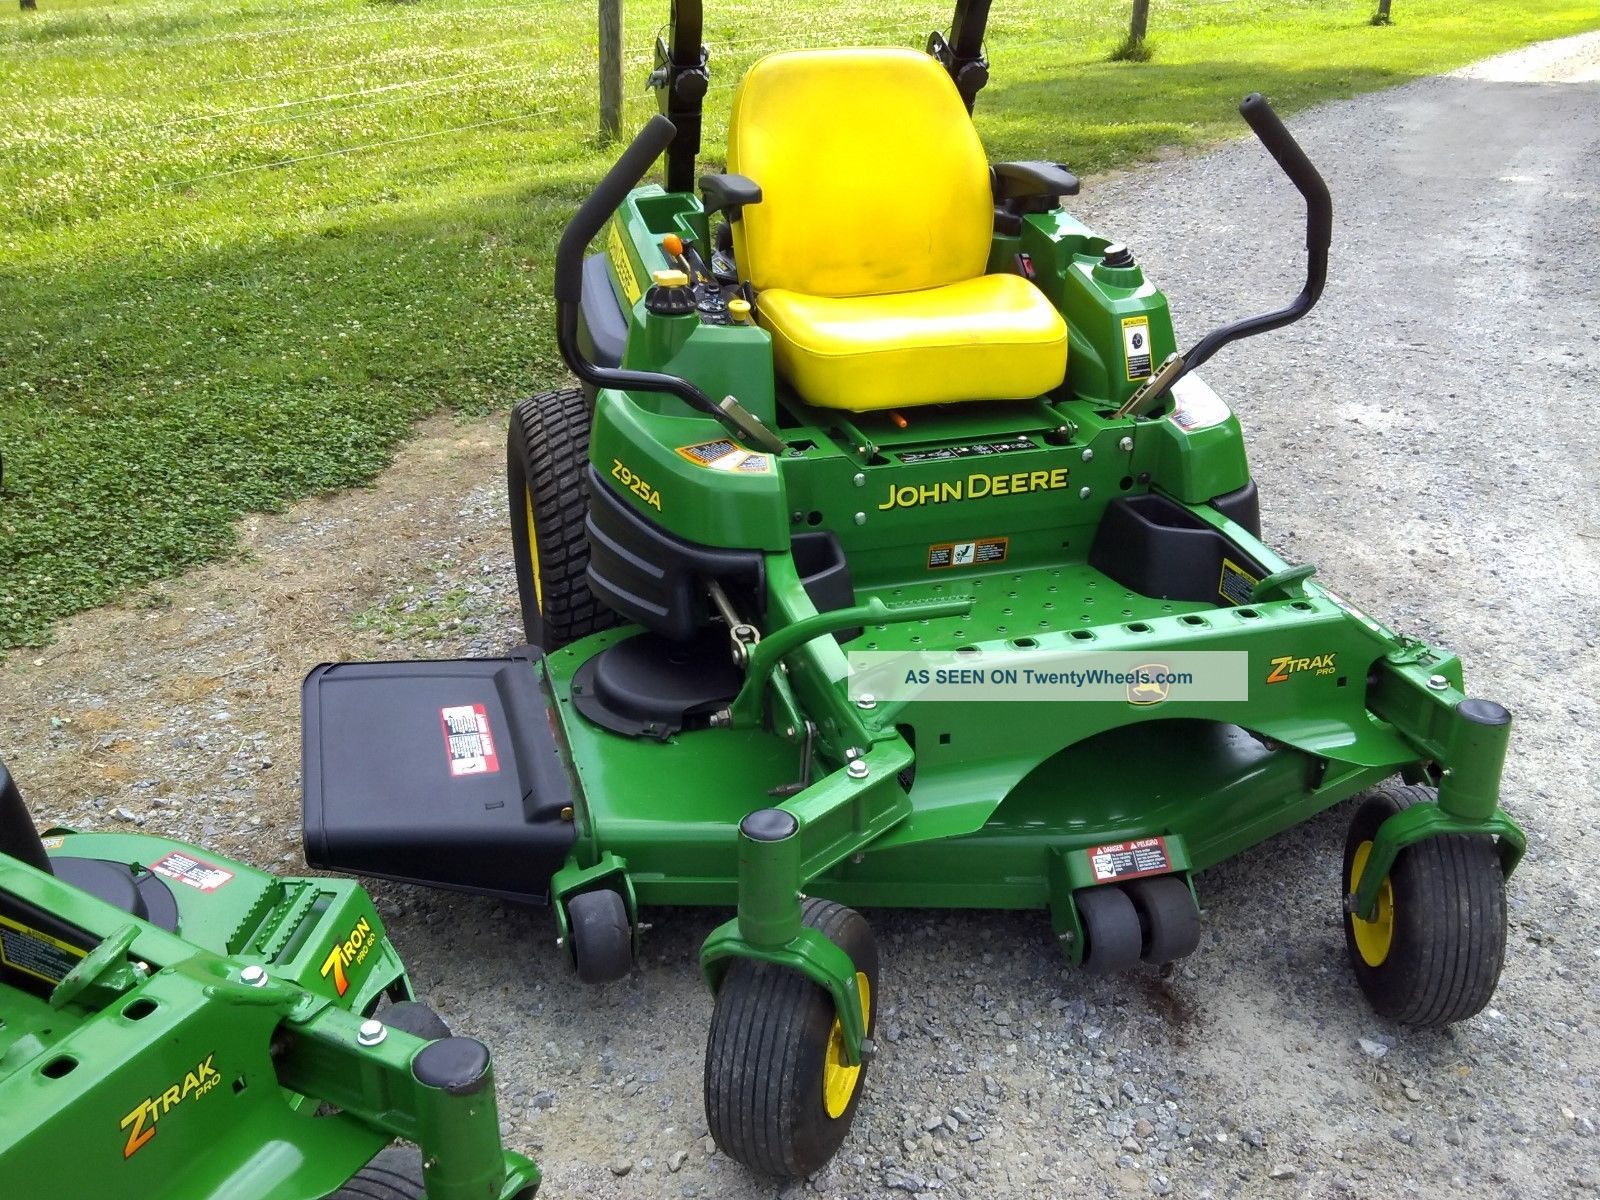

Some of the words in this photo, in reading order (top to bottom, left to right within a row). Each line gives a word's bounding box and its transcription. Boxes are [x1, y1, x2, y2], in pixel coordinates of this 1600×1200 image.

[611, 459, 662, 511] Z925A
[878, 480, 962, 510] JOHN
[968, 468, 1068, 499] DEERE
[1315, 666, 1336, 676] PRO
[1102, 844, 1125, 854] DANGER
[357, 945, 369, 965] PRO
[195, 1073, 221, 1101] PRO
